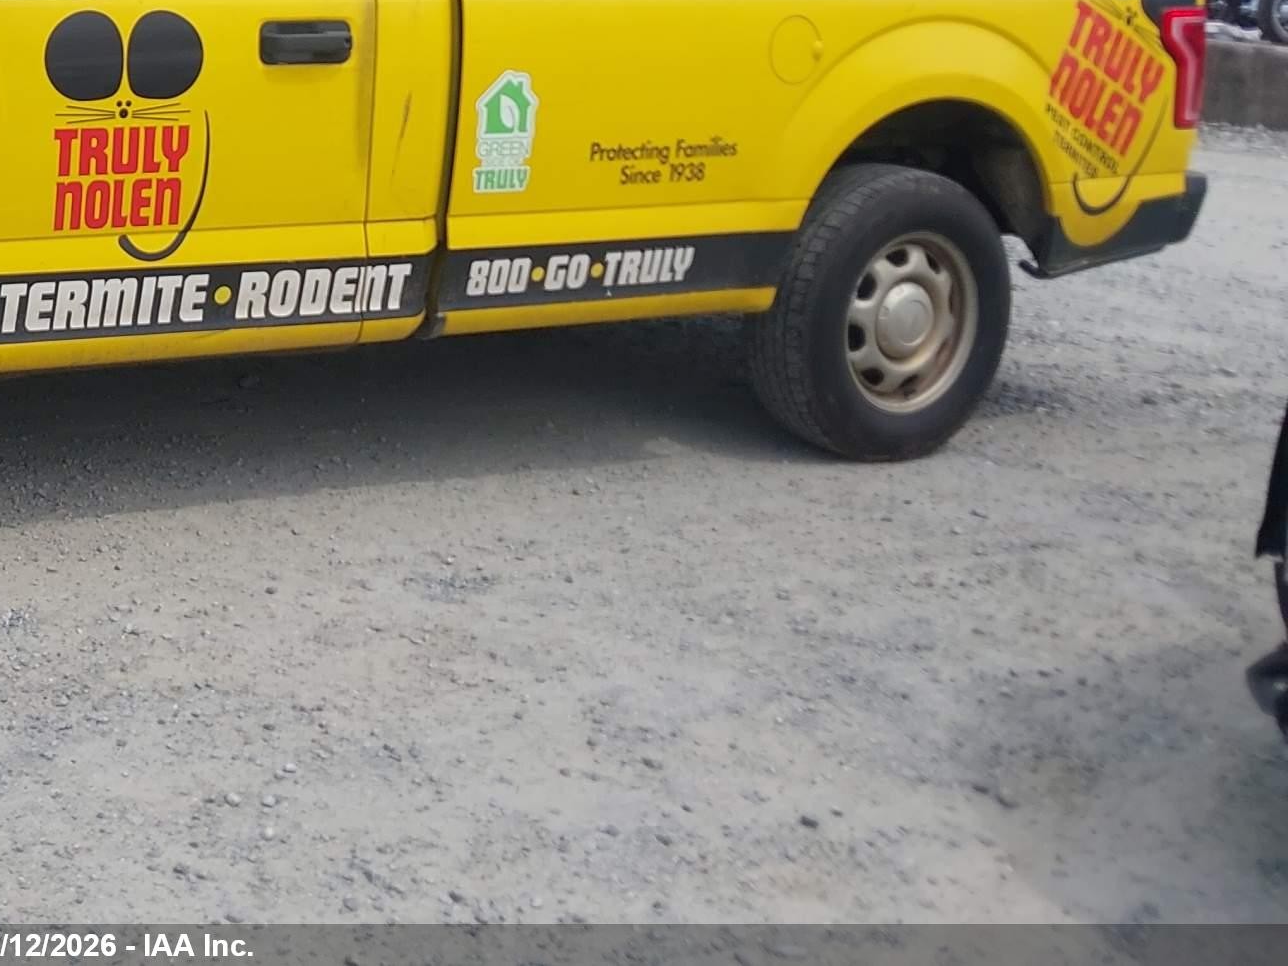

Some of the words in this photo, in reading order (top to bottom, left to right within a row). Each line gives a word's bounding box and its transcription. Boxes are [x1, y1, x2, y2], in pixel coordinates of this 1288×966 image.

[1068, 0, 1165, 103] TRULY
[1049, 52, 1142, 157] NOLEN
[54, 125, 190, 177] TRULY
[479, 140, 530, 157] GREEN
[590, 140, 670, 164] Protecting
[675, 135, 738, 157] Families
[620, 165, 661, 184] Since
[669, 161, 706, 182] 1938
[475, 168, 527, 189] TRULY
[54, 178, 182, 231] NOLEN
[466, 257, 532, 296] 800
[544, 254, 591, 290] GO
[603, 247, 696, 287] TRULY
[0, 273, 210, 333] TERMITE
[234, 263, 412, 320] RODENT
